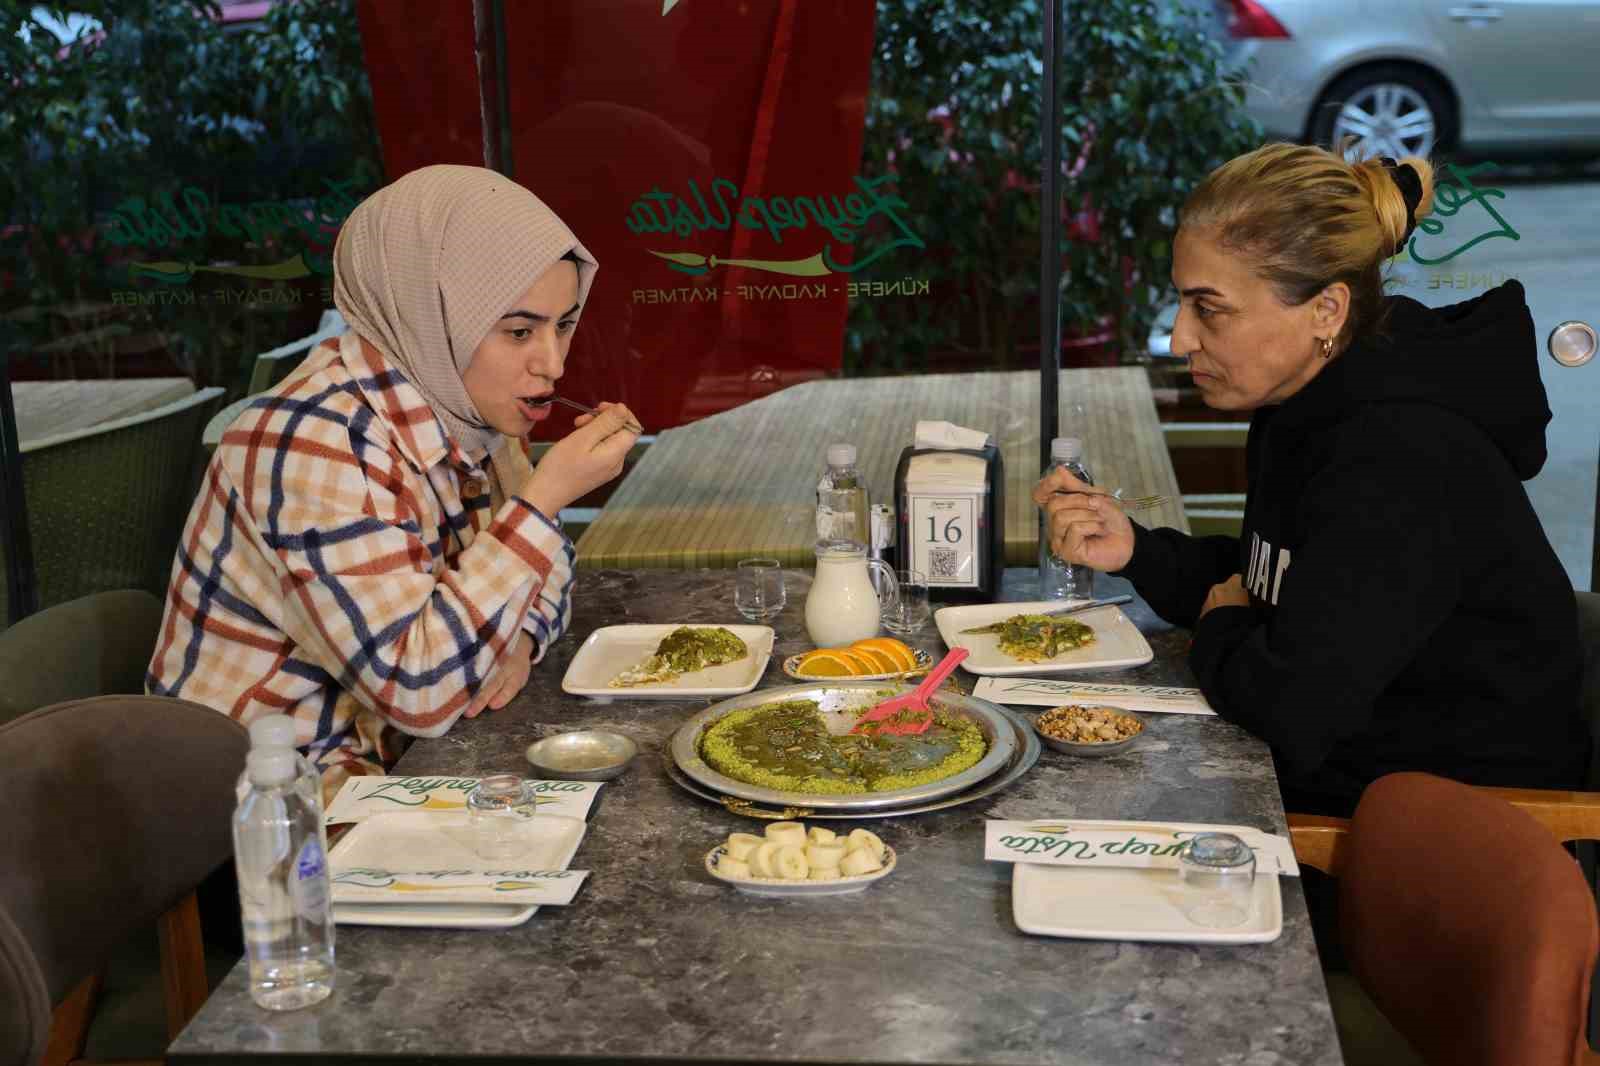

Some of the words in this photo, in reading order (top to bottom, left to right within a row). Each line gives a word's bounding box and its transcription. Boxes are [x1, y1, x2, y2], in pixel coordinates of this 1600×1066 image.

[926, 515, 962, 544] 16
[521, 779, 587, 793] sta
[1000, 835, 1098, 860] Usta
